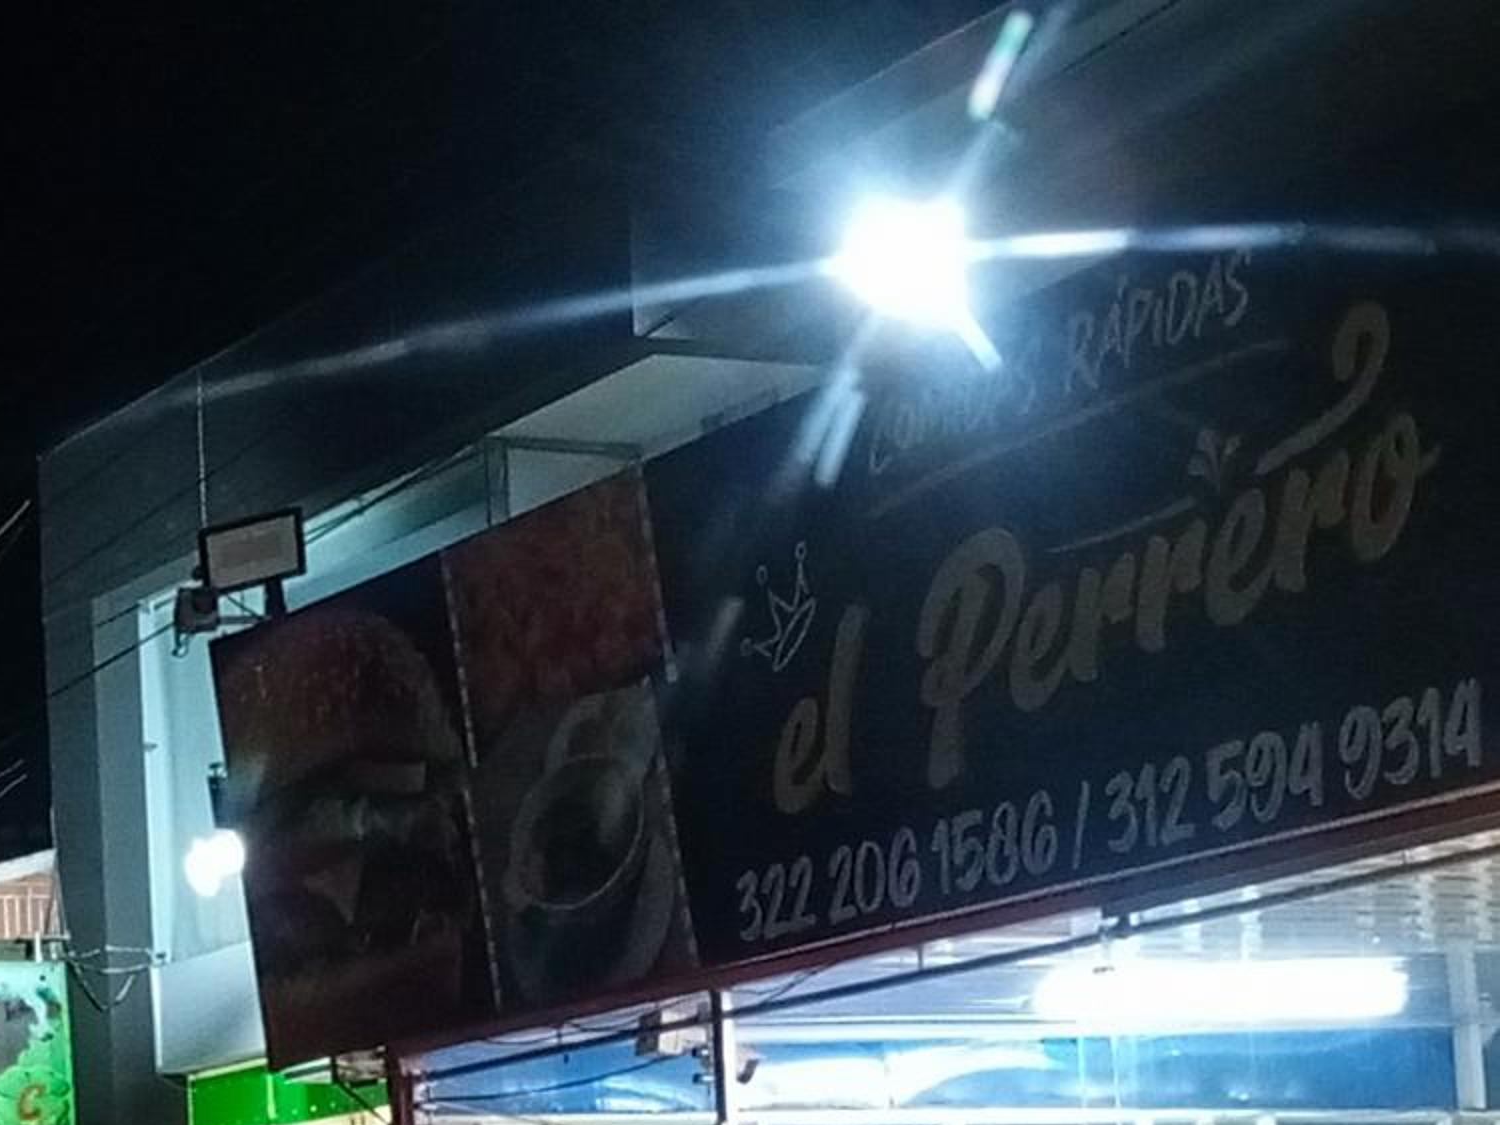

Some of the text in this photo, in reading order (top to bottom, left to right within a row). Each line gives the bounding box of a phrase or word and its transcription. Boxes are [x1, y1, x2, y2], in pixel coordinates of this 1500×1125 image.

[773, 300, 1443, 814] el Perrero
[736, 677, 1483, 942] 322 206 1586 / 312 594 9314
